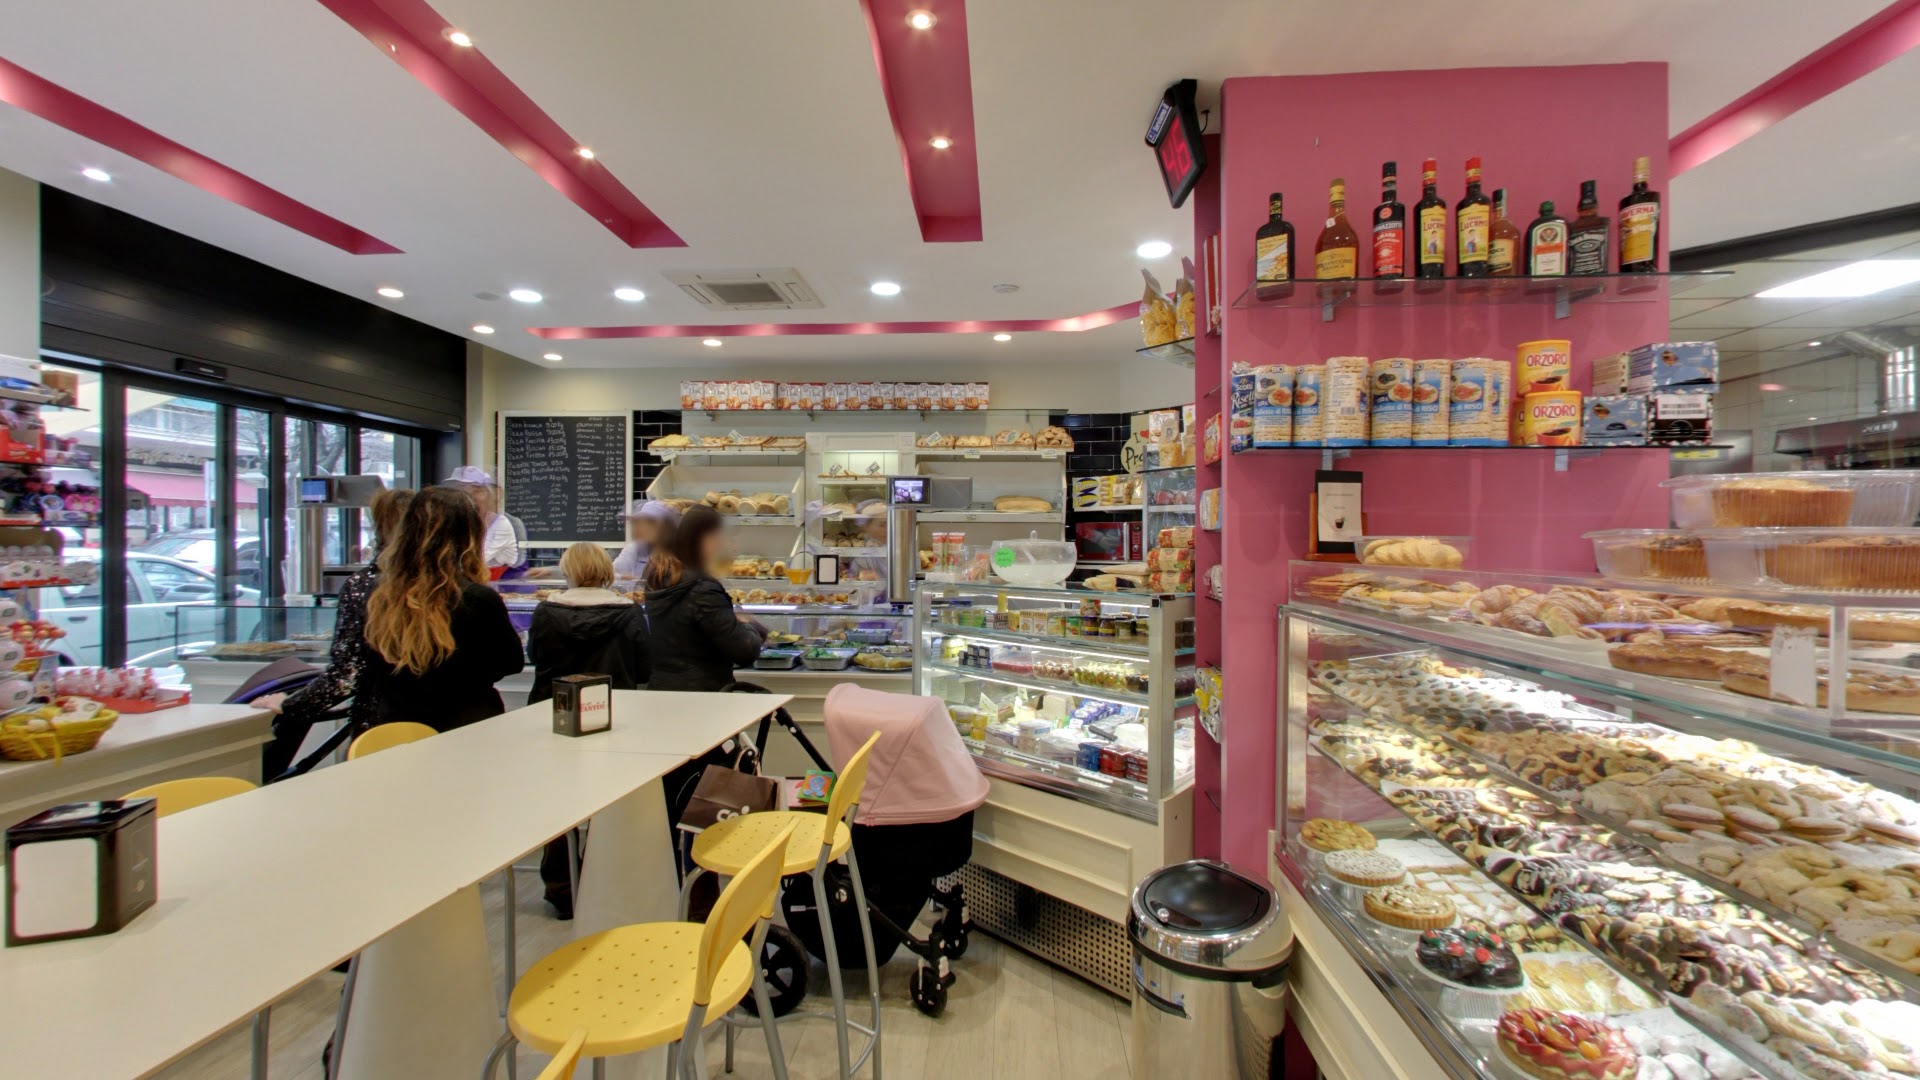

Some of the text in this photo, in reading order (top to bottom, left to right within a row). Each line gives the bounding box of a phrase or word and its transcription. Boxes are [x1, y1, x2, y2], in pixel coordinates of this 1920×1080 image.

[1526, 353, 1568, 367] ORZORO
[1533, 404, 1577, 419] ORZORO
[1133, 432, 1141, 443] I
